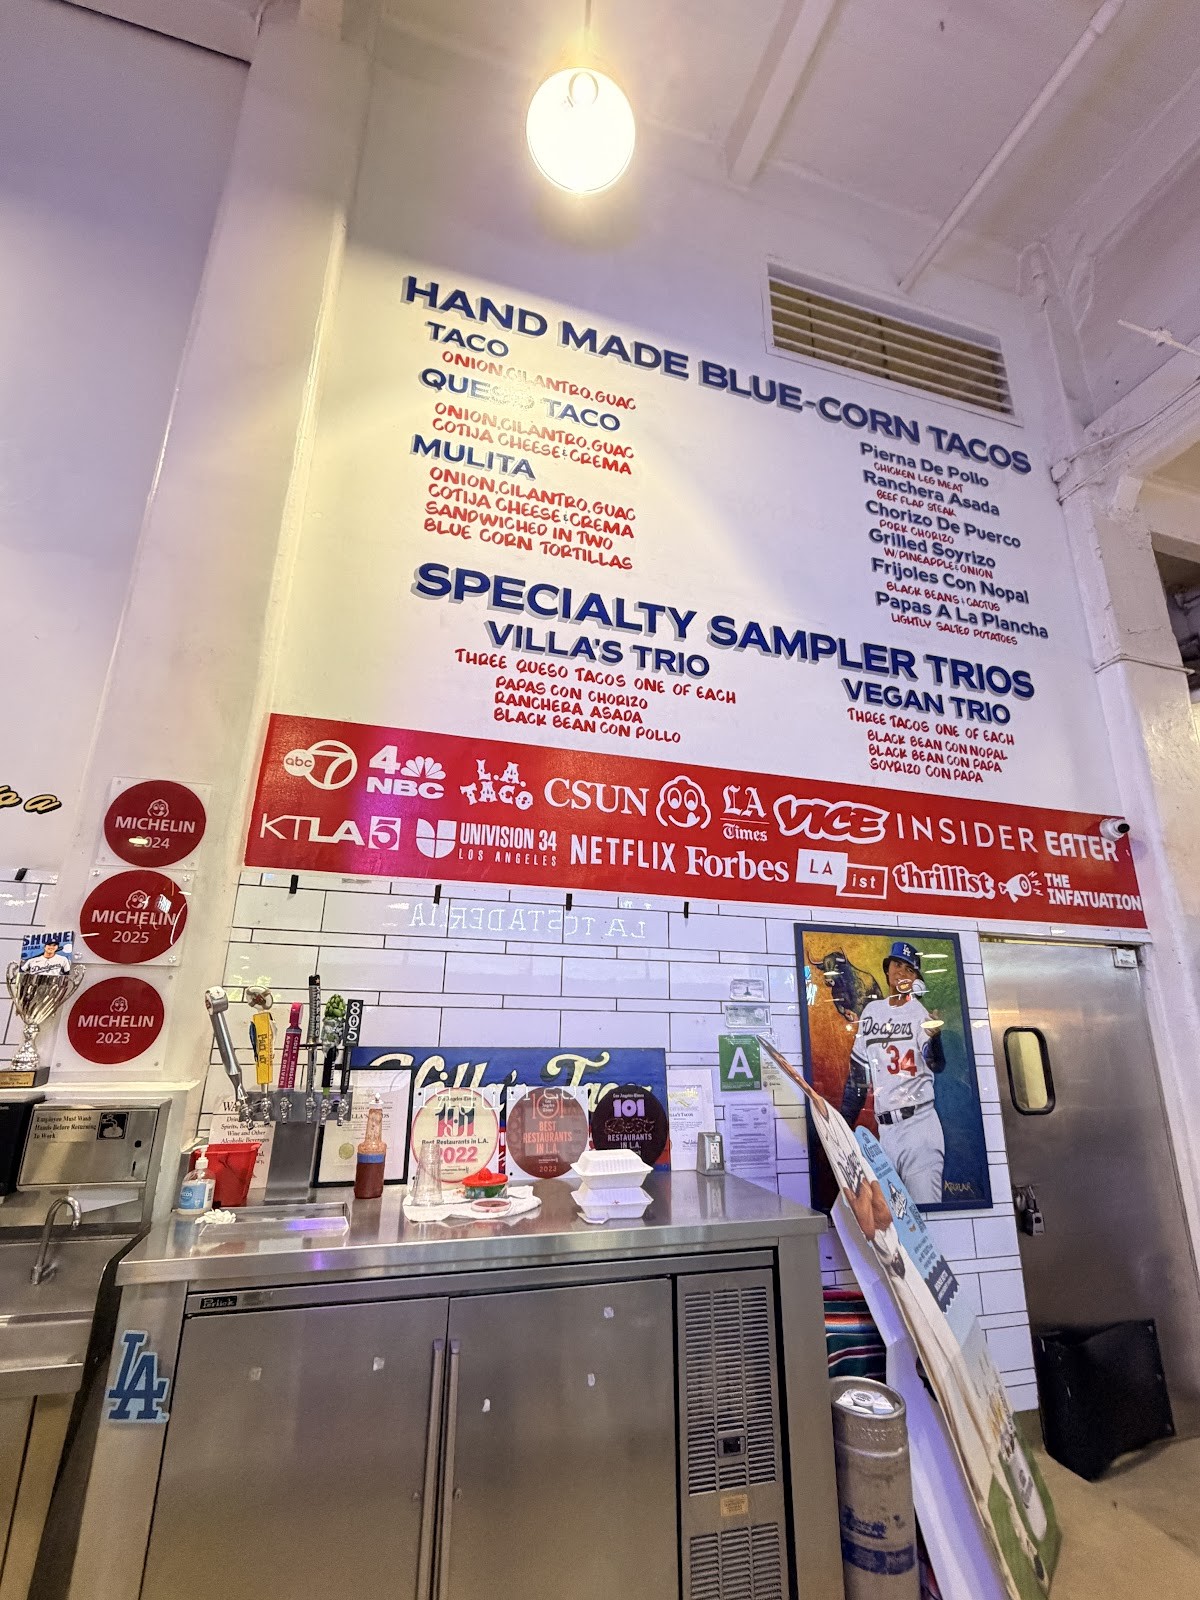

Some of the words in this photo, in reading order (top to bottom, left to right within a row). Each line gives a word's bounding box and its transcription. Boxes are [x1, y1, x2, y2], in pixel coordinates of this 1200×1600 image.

[425, 321, 510, 359] TACO
[400, 275, 548, 337] HAND
[558, 321, 689, 380] MADE
[698, 360, 920, 444] BLUE-CORN
[927, 425, 1032, 475] TACOS
[541, 398, 620, 431] TACO
[432, 418, 493, 444] COTIJA
[410, 434, 536, 480] MULITA
[859, 442, 916, 469] Pierna
[920, 459, 944, 476] De
[947, 465, 989, 487] Pollo
[863, 469, 944, 502] Ranchera
[948, 493, 1000, 516] Asada
[874, 462, 916, 480] CHICKEN
[918, 474, 935, 485] LEG
[938, 478, 964, 493] MEAT
[428, 484, 491, 509] COTIJA
[876, 489, 898, 502] BEEF
[900, 497, 924, 509] FLAP
[928, 502, 956, 517] STEAK
[425, 501, 547, 536] SANDWICHED
[552, 527, 572, 542] IN
[576, 530, 613, 550] TWO
[866, 499, 933, 527] Chorizo
[936, 516, 960, 534] De
[964, 522, 1022, 548] Puerco
[880, 520, 908, 533] PORK
[911, 526, 954, 545] CHORIZO
[424, 518, 472, 540] BLUE
[480, 529, 532, 550] CORN
[540, 541, 633, 570] TORTILLAS
[868, 528, 927, 553] Grilled
[932, 541, 996, 568] Soyrizo
[871, 557, 938, 584] Frijoles
[942, 573, 981, 592] Con
[980, 580, 1030, 604] Nopal
[886, 581, 922, 596] BLACK
[924, 589, 960, 604] BEANS
[966, 597, 1000, 612] CACTUS
[875, 590, 932, 615] Papas
[936, 604, 950, 619] A
[955, 607, 978, 625] La
[981, 611, 1049, 638] Plancha
[891, 613, 932, 628] LIGHTLY
[936, 622, 970, 636] SALTED
[973, 628, 1018, 646] POTATOES
[410, 562, 698, 642] SPECIALTY
[706, 614, 918, 682] SAMPLER
[923, 653, 1035, 700] TRIOS
[484, 620, 624, 665] VILLA'S
[630, 645, 710, 680] TRIO
[454, 648, 508, 670] THREE
[516, 659, 568, 679] QUESO
[575, 666, 626, 688] TACOS
[634, 677, 666, 694] ONE
[673, 684, 692, 696] OF
[696, 686, 736, 704] EACH
[494, 692, 584, 716] RANCHERA
[590, 704, 643, 724] ASADA
[496, 676, 546, 696] PAPAS
[550, 684, 582, 700] CON
[588, 689, 648, 710] CHORIZO
[841, 677, 945, 716] VEGAN
[948, 696, 1011, 726] TRIO
[494, 708, 547, 727] BLACK
[552, 715, 596, 734] BEAN
[599, 721, 631, 738] CON
[635, 726, 681, 744] POLLO
[848, 707, 886, 726] THREE
[890, 715, 930, 732] TACOS
[935, 723, 959, 738] ONE
[965, 728, 978, 740] OF
[982, 730, 1014, 746] EACH
[368, 744, 400, 774] 4
[867, 729, 906, 746] BLACK
[910, 736, 942, 752] BEAN
[944, 739, 968, 754] CON
[969, 744, 1008, 760] NOPAL
[868, 745, 908, 760] BLACK
[911, 750, 944, 766] BEAN
[946, 754, 970, 768] CON
[973, 758, 1002, 773] PAPA
[285, 754, 313, 769] abc
[476, 759, 526, 787] L.A.
[870, 758, 921, 776] SOYRIZO
[926, 764, 950, 779] CON
[954, 768, 984, 784] PAPA
[366, 776, 444, 800] NBC
[460, 781, 534, 810] TACO
[543, 777, 649, 816] CSUN
[722, 784, 766, 818] LA
[115, 816, 196, 833] MICHELIN
[260, 813, 365, 846] KTLA
[371, 818, 400, 850] 5
[722, 823, 767, 842] Times
[773, 794, 890, 844] VICE
[896, 812, 1038, 853] INSIDER
[460, 822, 535, 850] UNIVISION
[539, 830, 557, 852] 34
[1045, 830, 1119, 862] EATER
[458, 848, 484, 862] LOS
[495, 850, 556, 867] ANGELES
[570, 834, 676, 874] NETFLIX
[684, 845, 789, 882] Forbes
[893, 862, 995, 900] thrillist
[1045, 872, 1070, 888] THE
[1047, 888, 1144, 912] INFATUATION
[91, 910, 176, 926] MICHELIN
[112, 930, 149, 944] 2025
[78, 1014, 154, 1028] MICHELIN
[346, 1002, 360, 1041] 805
[862, 1016, 914, 1048] Dodgers
[96, 1032, 130, 1044] 2023
[727, 1047, 753, 1079] A
[887, 1045, 918, 1076] 34
[613, 1100, 645, 1118] 101
[523, 1132, 572, 1142] RESTAURANTS
[539, 1122, 556, 1130] BEST
[608, 1134, 652, 1142] RESTAURANTS
[437, 1146, 478, 1164] 022
[536, 1144, 544, 1154] IN
[108, 1333, 169, 1420] LA
